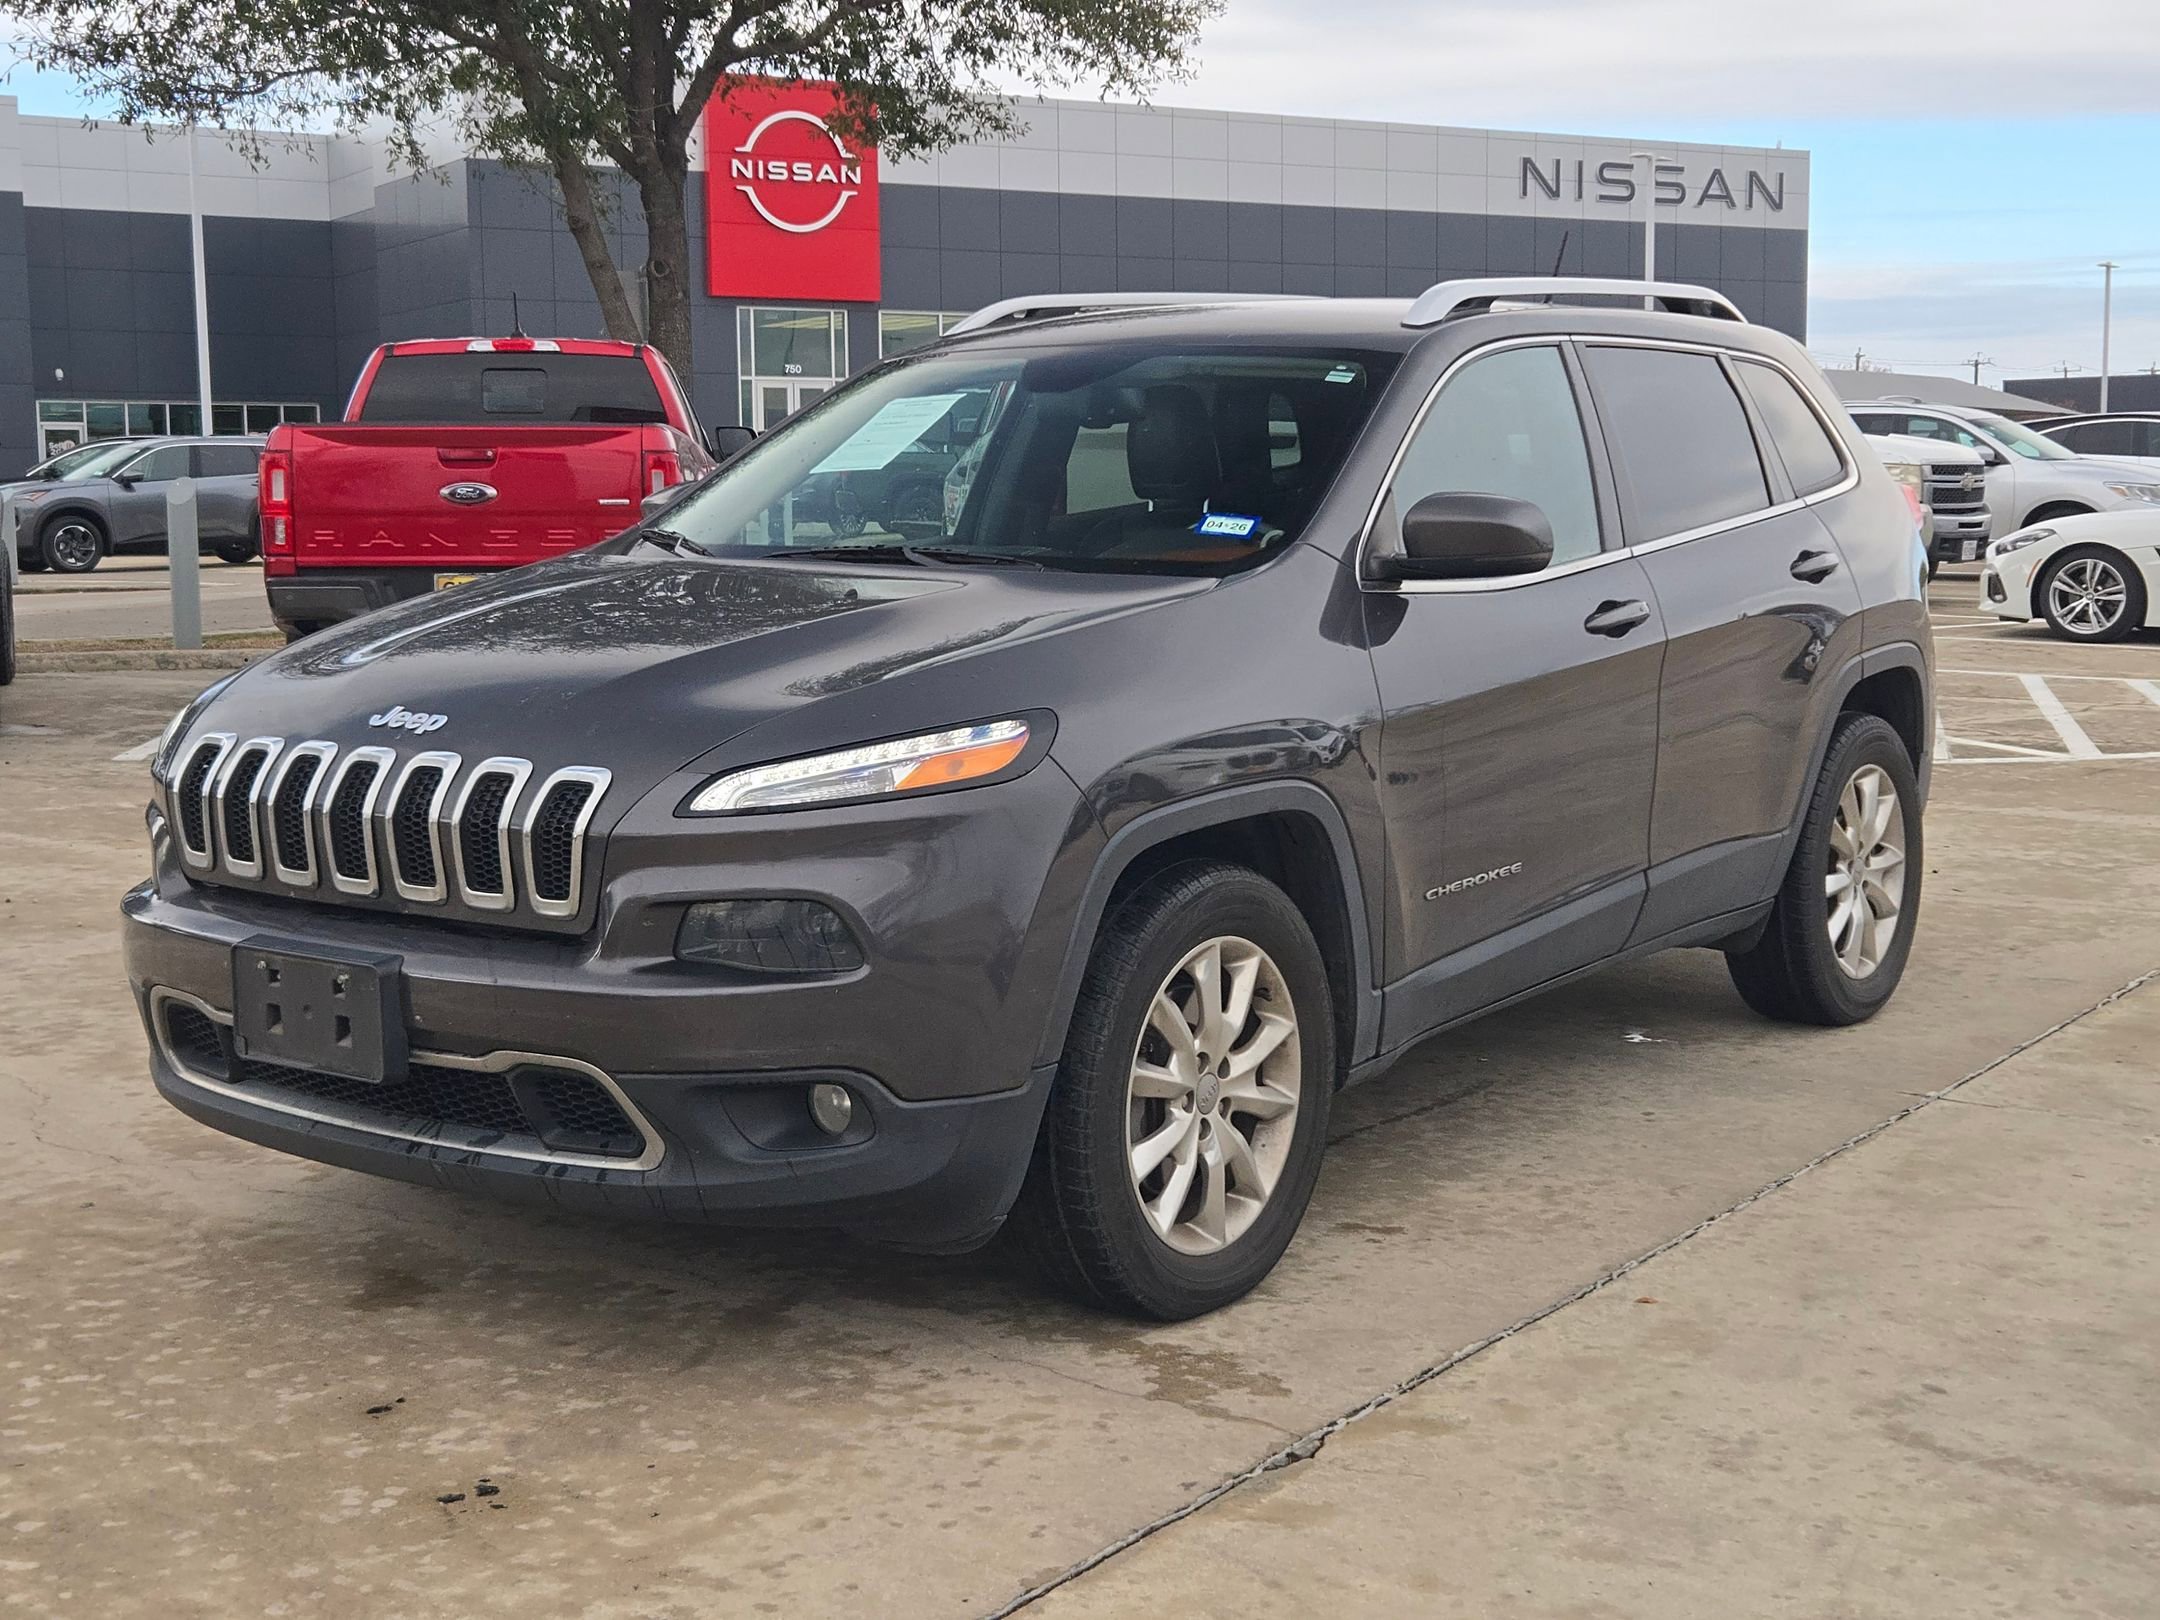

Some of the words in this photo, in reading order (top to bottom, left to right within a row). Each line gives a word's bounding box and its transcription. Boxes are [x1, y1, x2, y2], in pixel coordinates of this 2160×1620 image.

[731, 158, 861, 184] NISSAN
[1520, 156, 1785, 211] NISSAN
[784, 363, 802, 374] 750
[368, 705, 448, 735] Jeep
[1425, 861, 1523, 901] CHEROKEE
